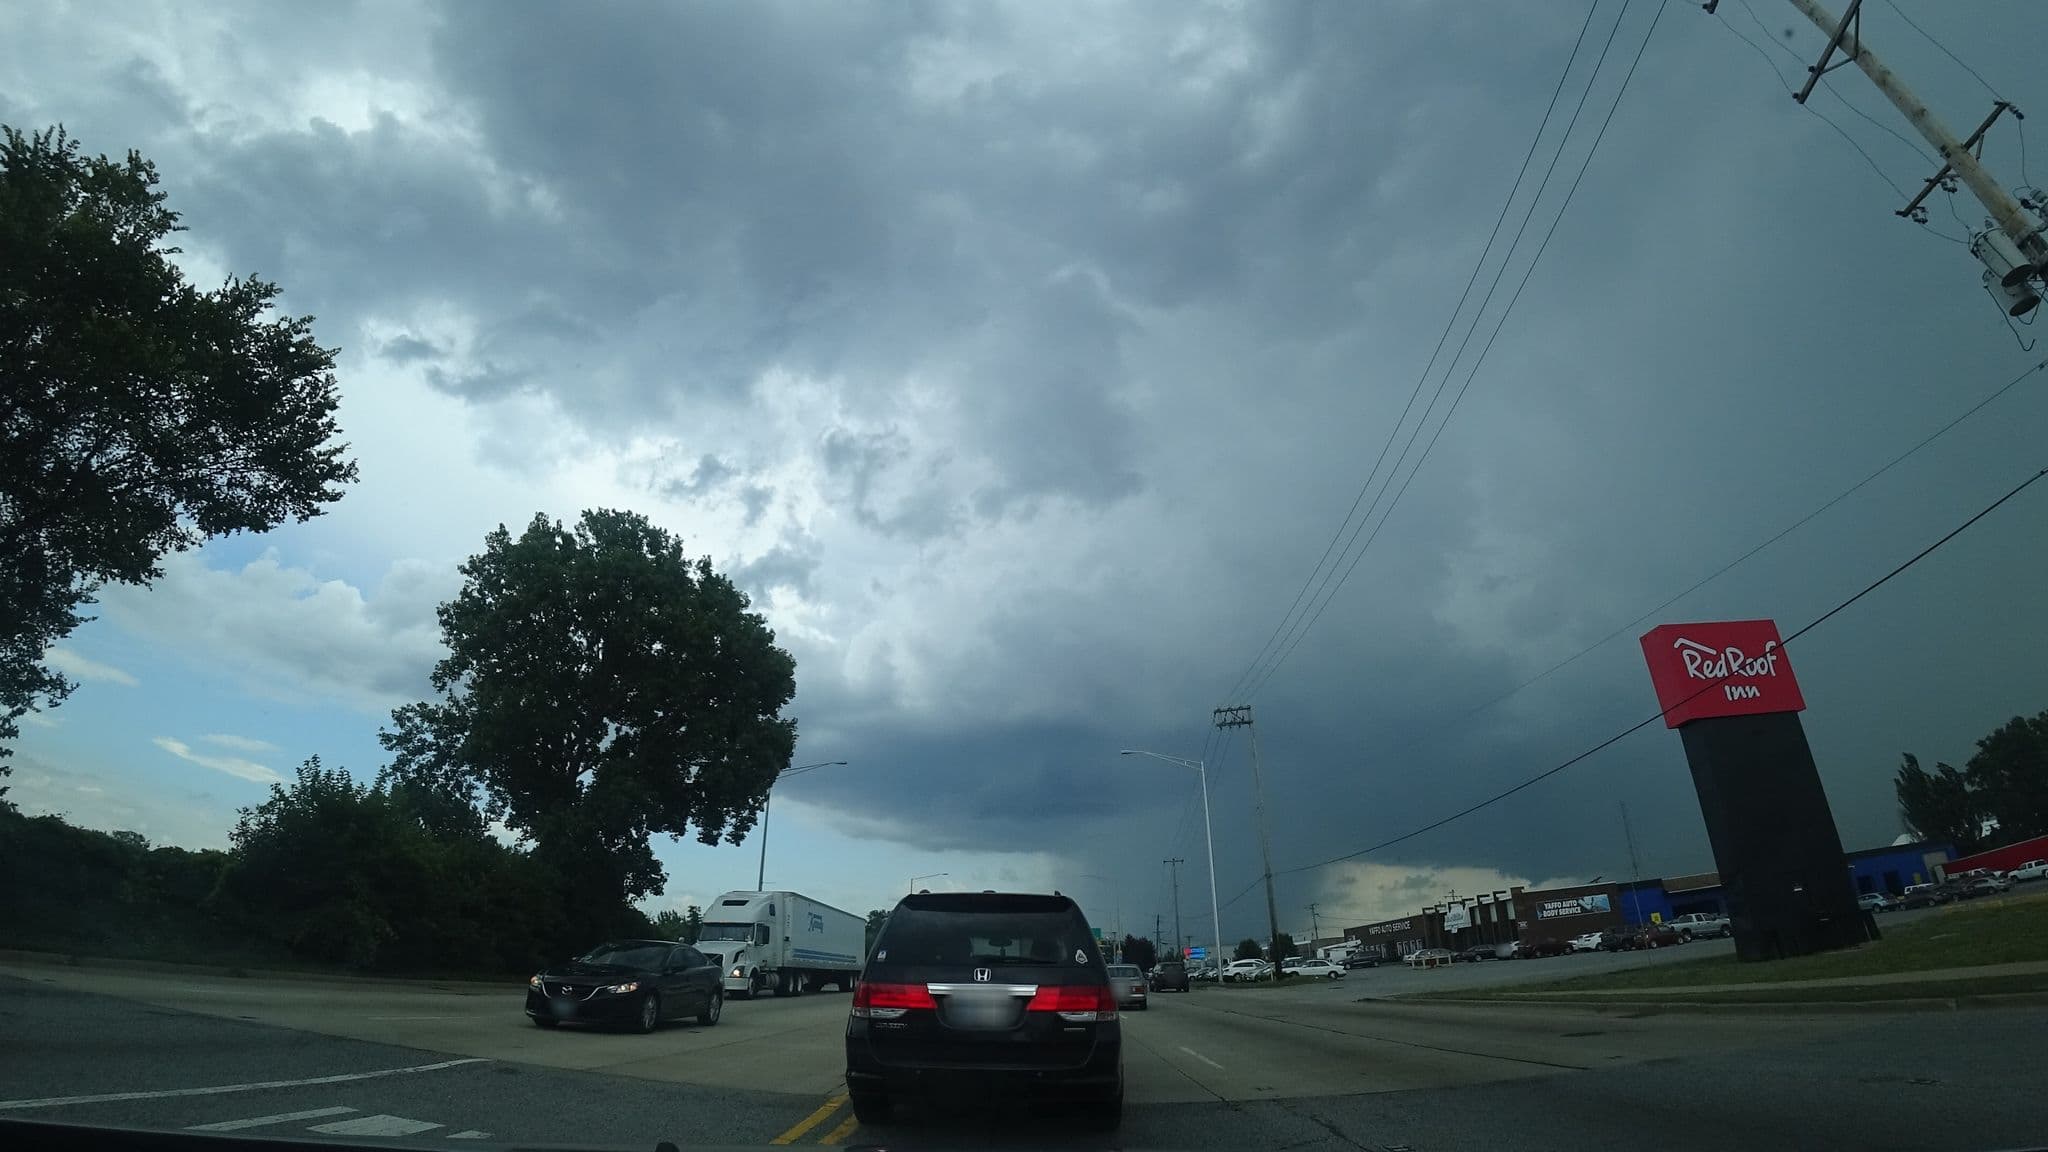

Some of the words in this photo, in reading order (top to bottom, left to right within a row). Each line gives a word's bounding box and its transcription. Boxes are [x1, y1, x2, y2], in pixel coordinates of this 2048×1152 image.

[1724, 684, 1761, 701] Inn
[1544, 902, 1562, 910] YAFFO
[1562, 899, 1578, 908] AUTO
[1543, 909, 1558, 917] BODY
[1558, 906, 1581, 916] SERVICE
